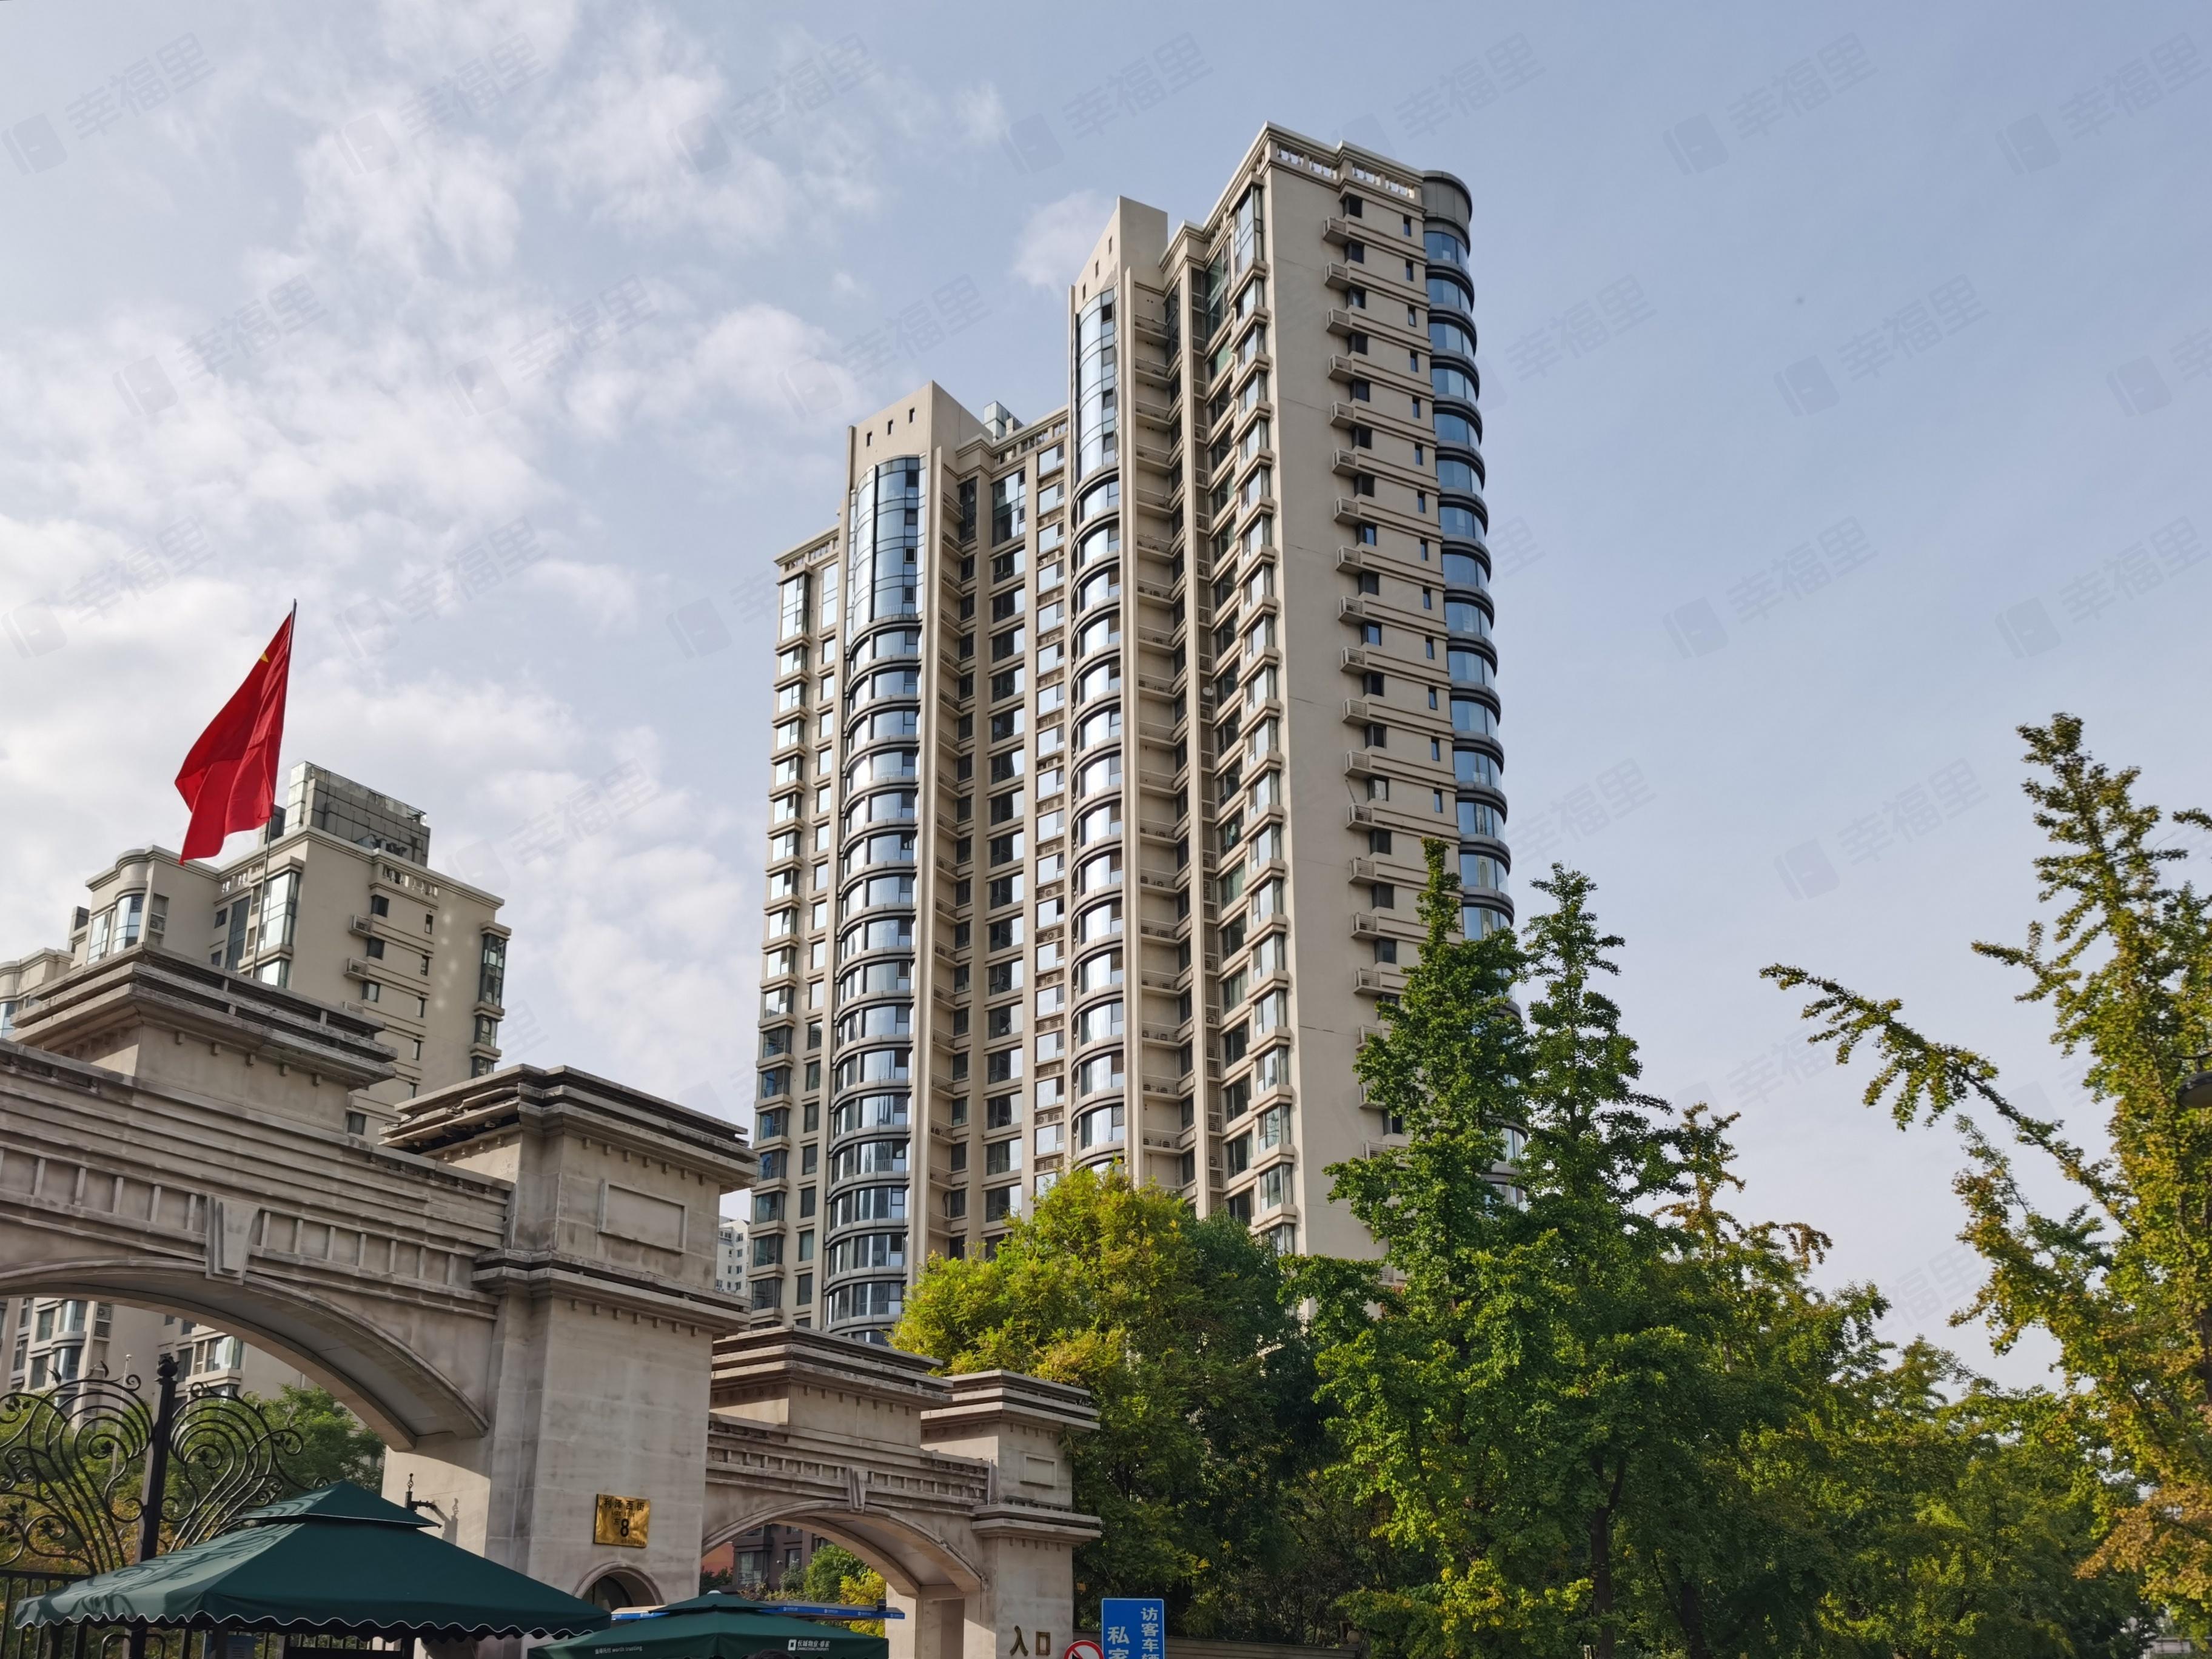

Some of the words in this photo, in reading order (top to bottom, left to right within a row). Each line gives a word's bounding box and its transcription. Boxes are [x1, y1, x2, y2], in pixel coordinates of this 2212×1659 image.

[603, 1497, 645, 1512] 利泽西街
[620, 1518, 629, 1537] 8
[1010, 1625, 1051, 1656] 入口
